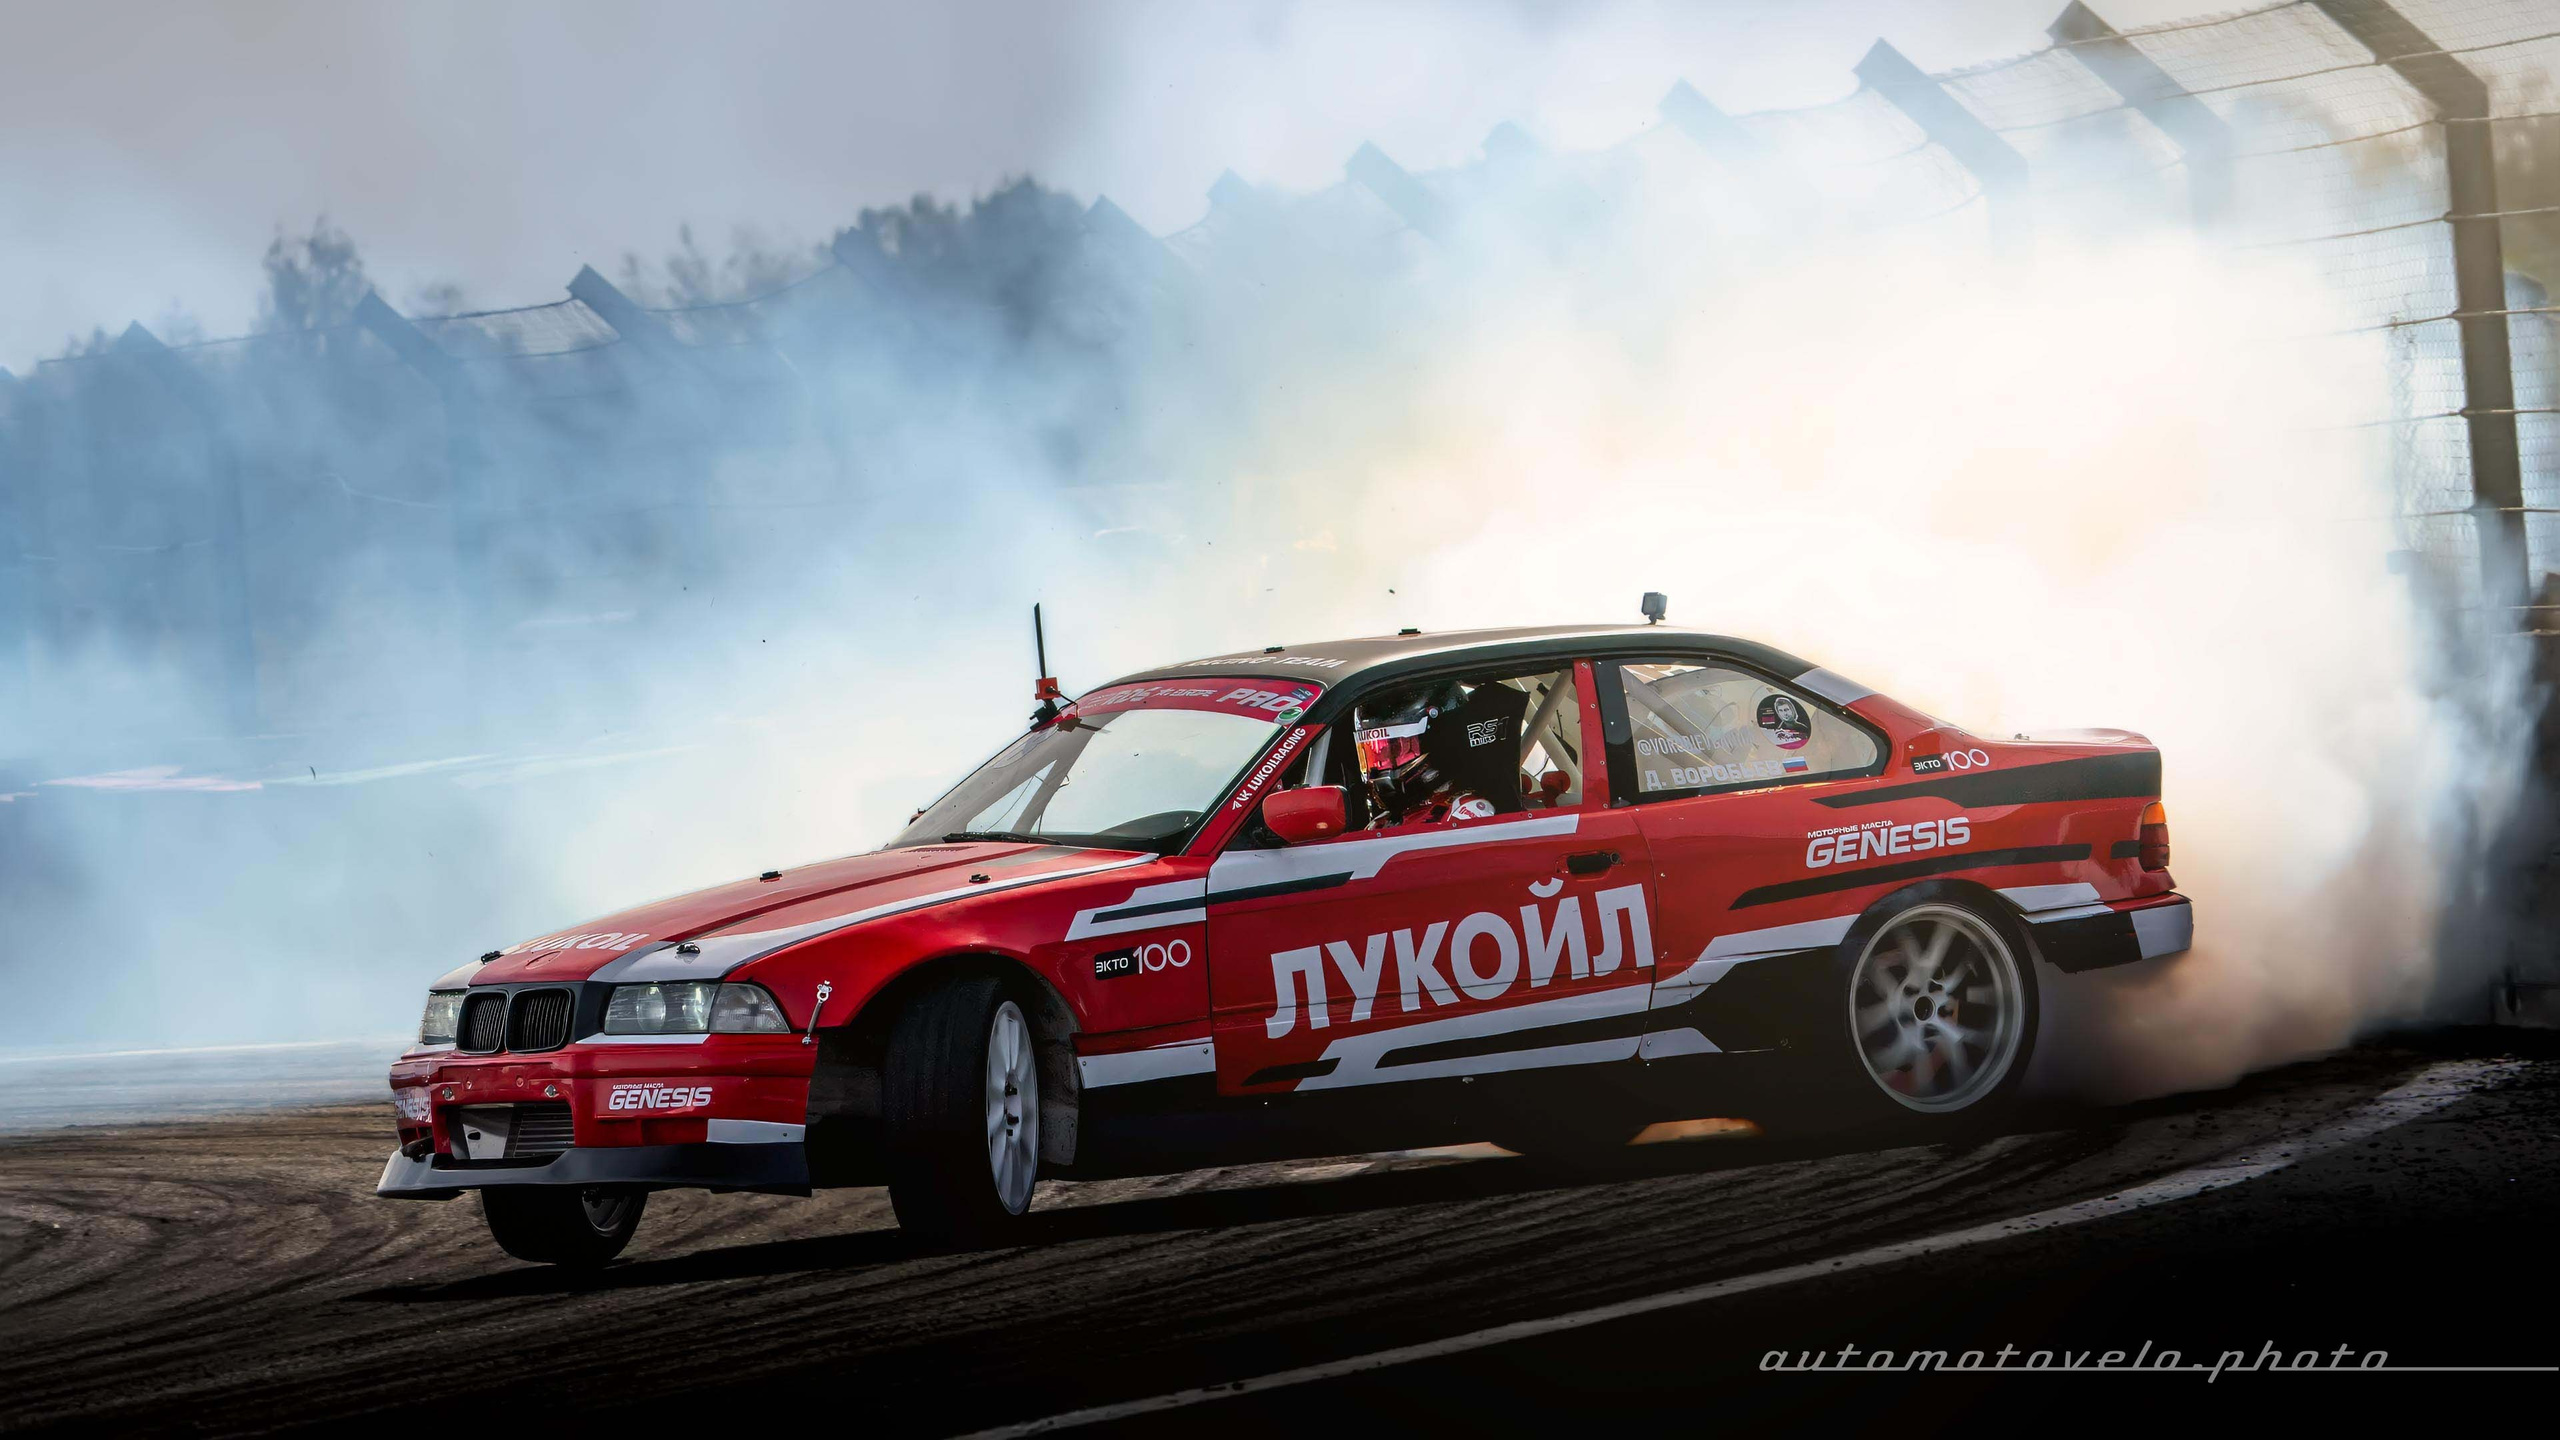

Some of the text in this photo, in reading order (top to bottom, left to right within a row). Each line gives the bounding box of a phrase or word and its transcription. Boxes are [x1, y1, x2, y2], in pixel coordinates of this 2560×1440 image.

[1216, 688, 1303, 712] PRO
[1247, 727, 1306, 791] LUKOILRACING
[1914, 748, 1990, 771] ЭКТО 100
[1645, 760, 1783, 791] Д. ВОРОБЬЕВ
[1805, 816, 1971, 869] GENESIS
[1807, 819, 1894, 839] МОТОРНЫЕ МАСЛА
[511, 932, 650, 953] LUKOIL
[1095, 939, 1192, 974] ЭКТО 100
[1265, 877, 1655, 1039] ЛУКОЙЛ
[608, 1087, 713, 1111] GENESIS
